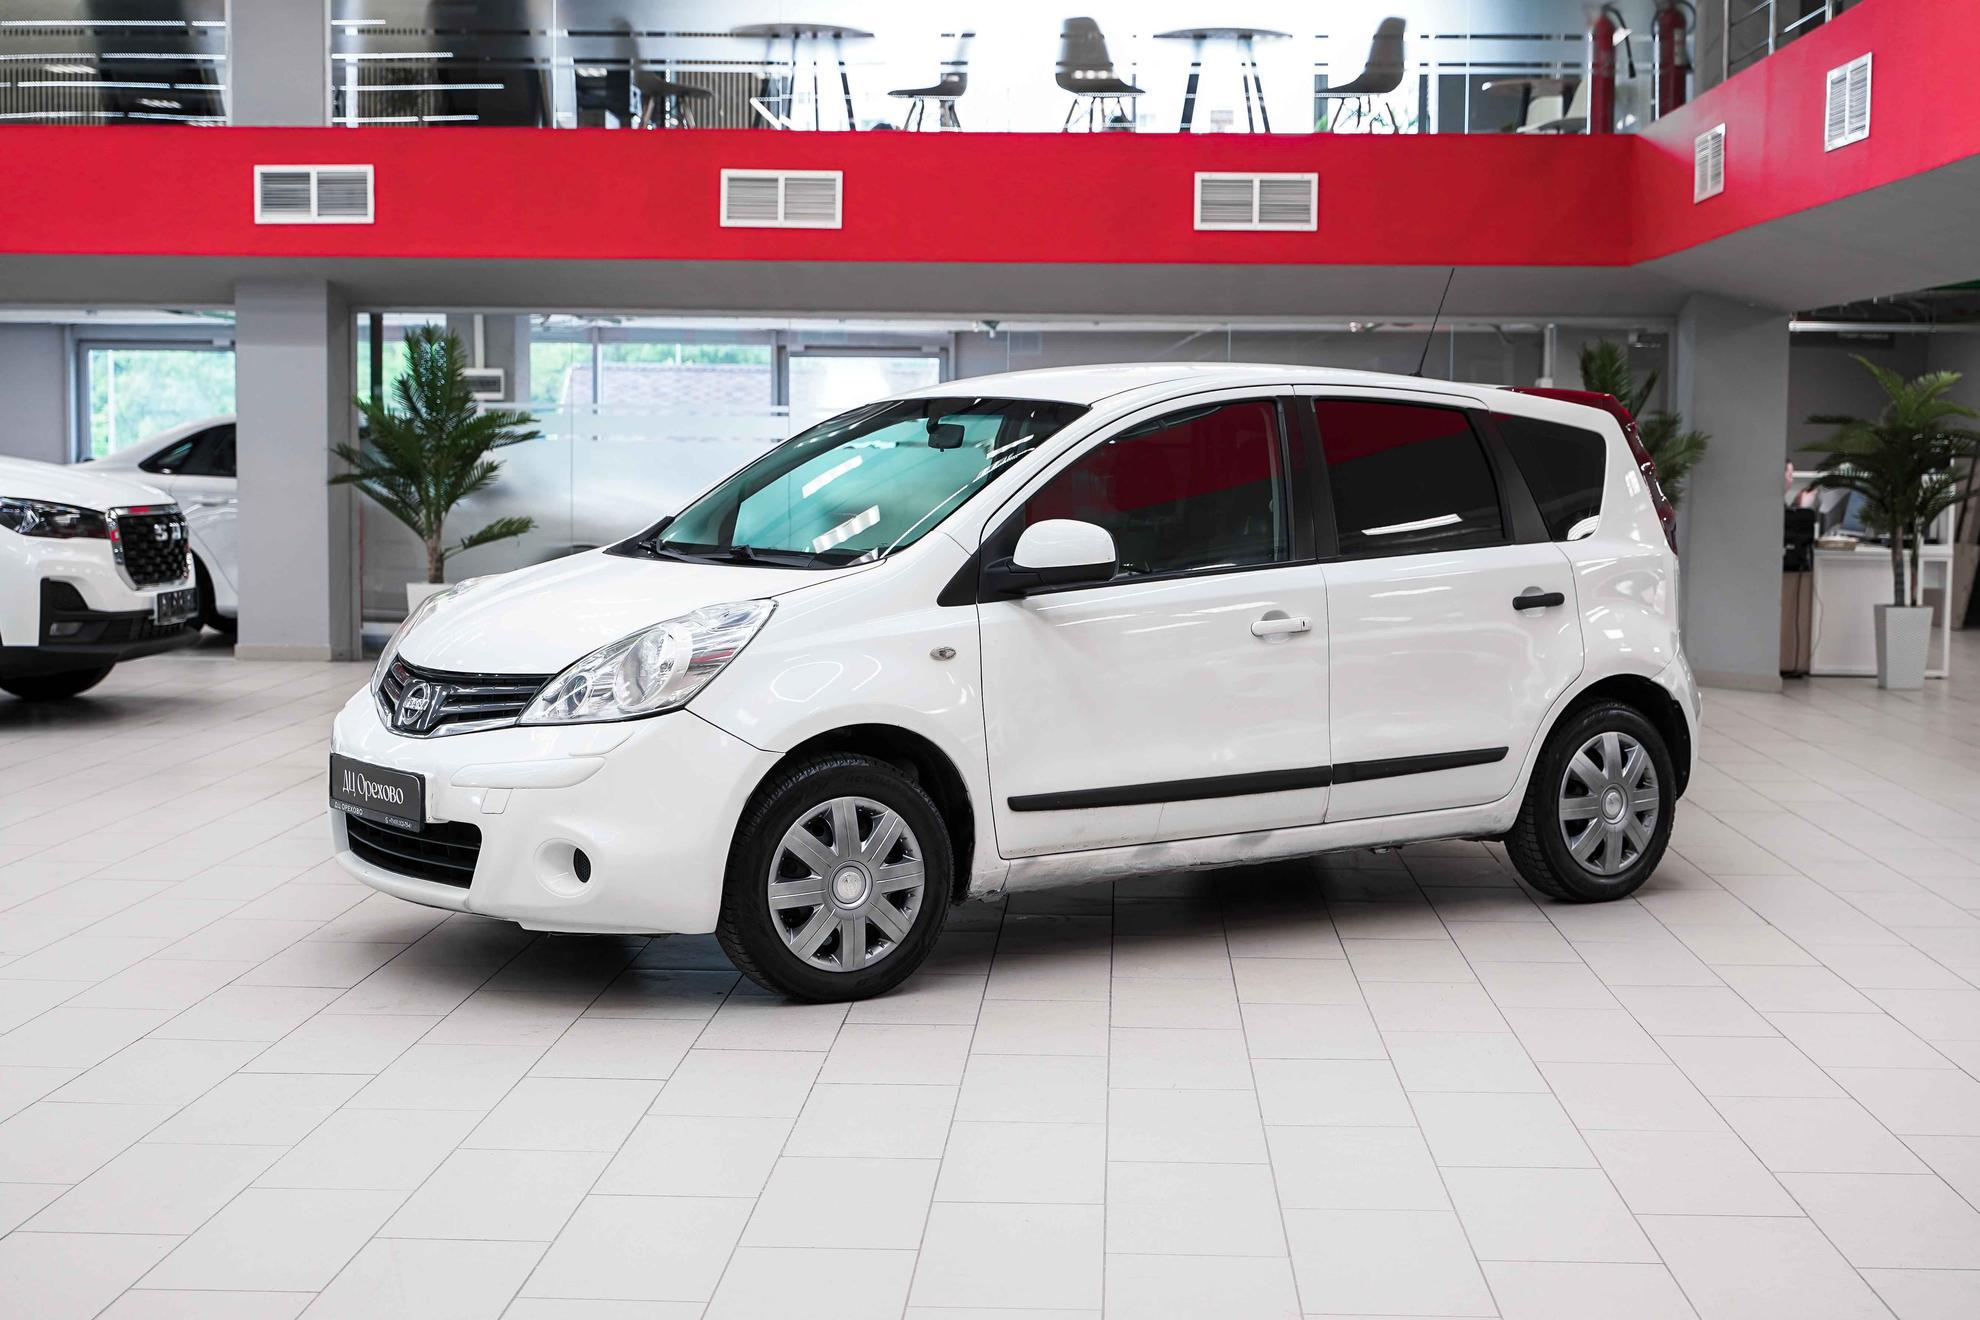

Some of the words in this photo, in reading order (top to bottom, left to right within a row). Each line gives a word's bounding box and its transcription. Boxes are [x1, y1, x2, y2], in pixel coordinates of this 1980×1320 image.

[342, 769, 356, 797] ДЦ
[357, 773, 404, 805] Орехово
[341, 804, 363, 816] ОРЕХОВО
